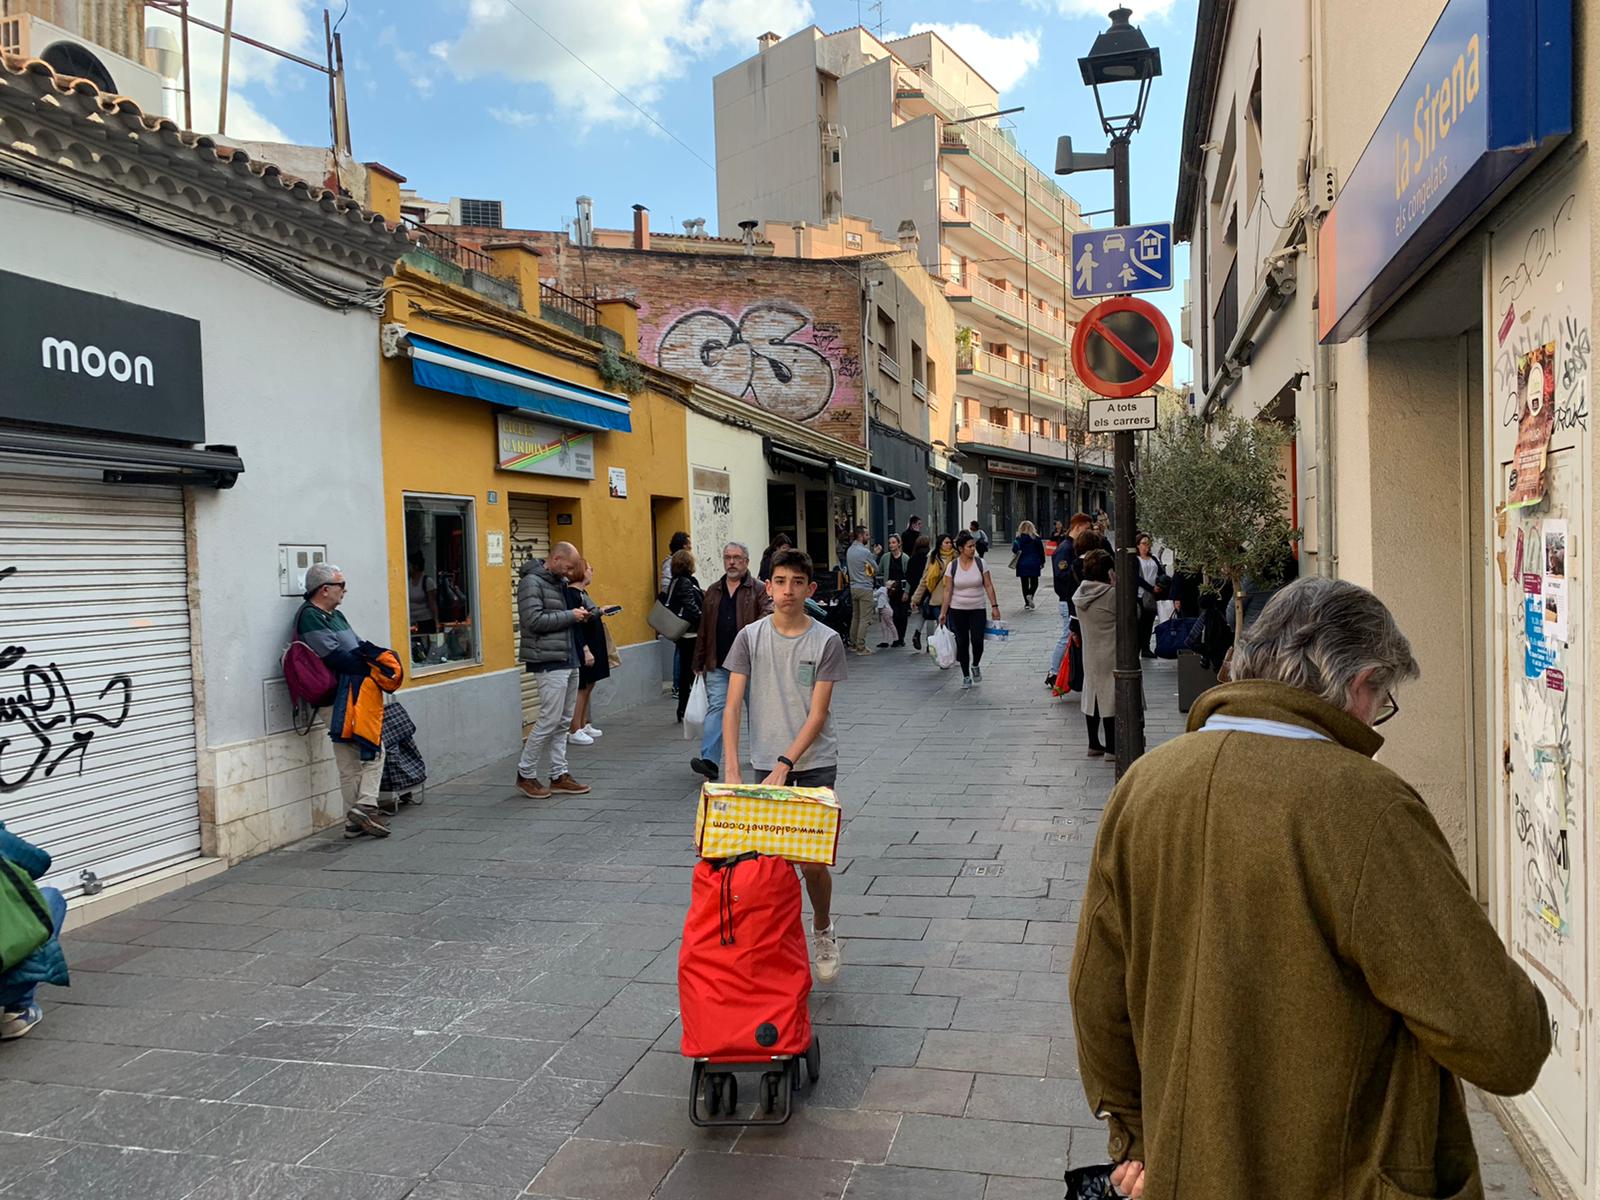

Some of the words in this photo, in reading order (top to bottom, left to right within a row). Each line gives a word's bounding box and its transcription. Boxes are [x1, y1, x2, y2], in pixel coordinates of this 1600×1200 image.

[1395, 132, 1410, 200] la
[1413, 32, 1480, 175] Sirena
[1395, 203, 1407, 237] els
[1407, 155, 1447, 219] congelats
[41, 336, 154, 386] moon
[1094, 417, 1110, 427] els
[1113, 415, 1151, 426] carrers
[1107, 403, 1116, 412] A
[1117, 403, 1137, 412] tots
[712, 821, 824, 834] www.caldoaneto.com
